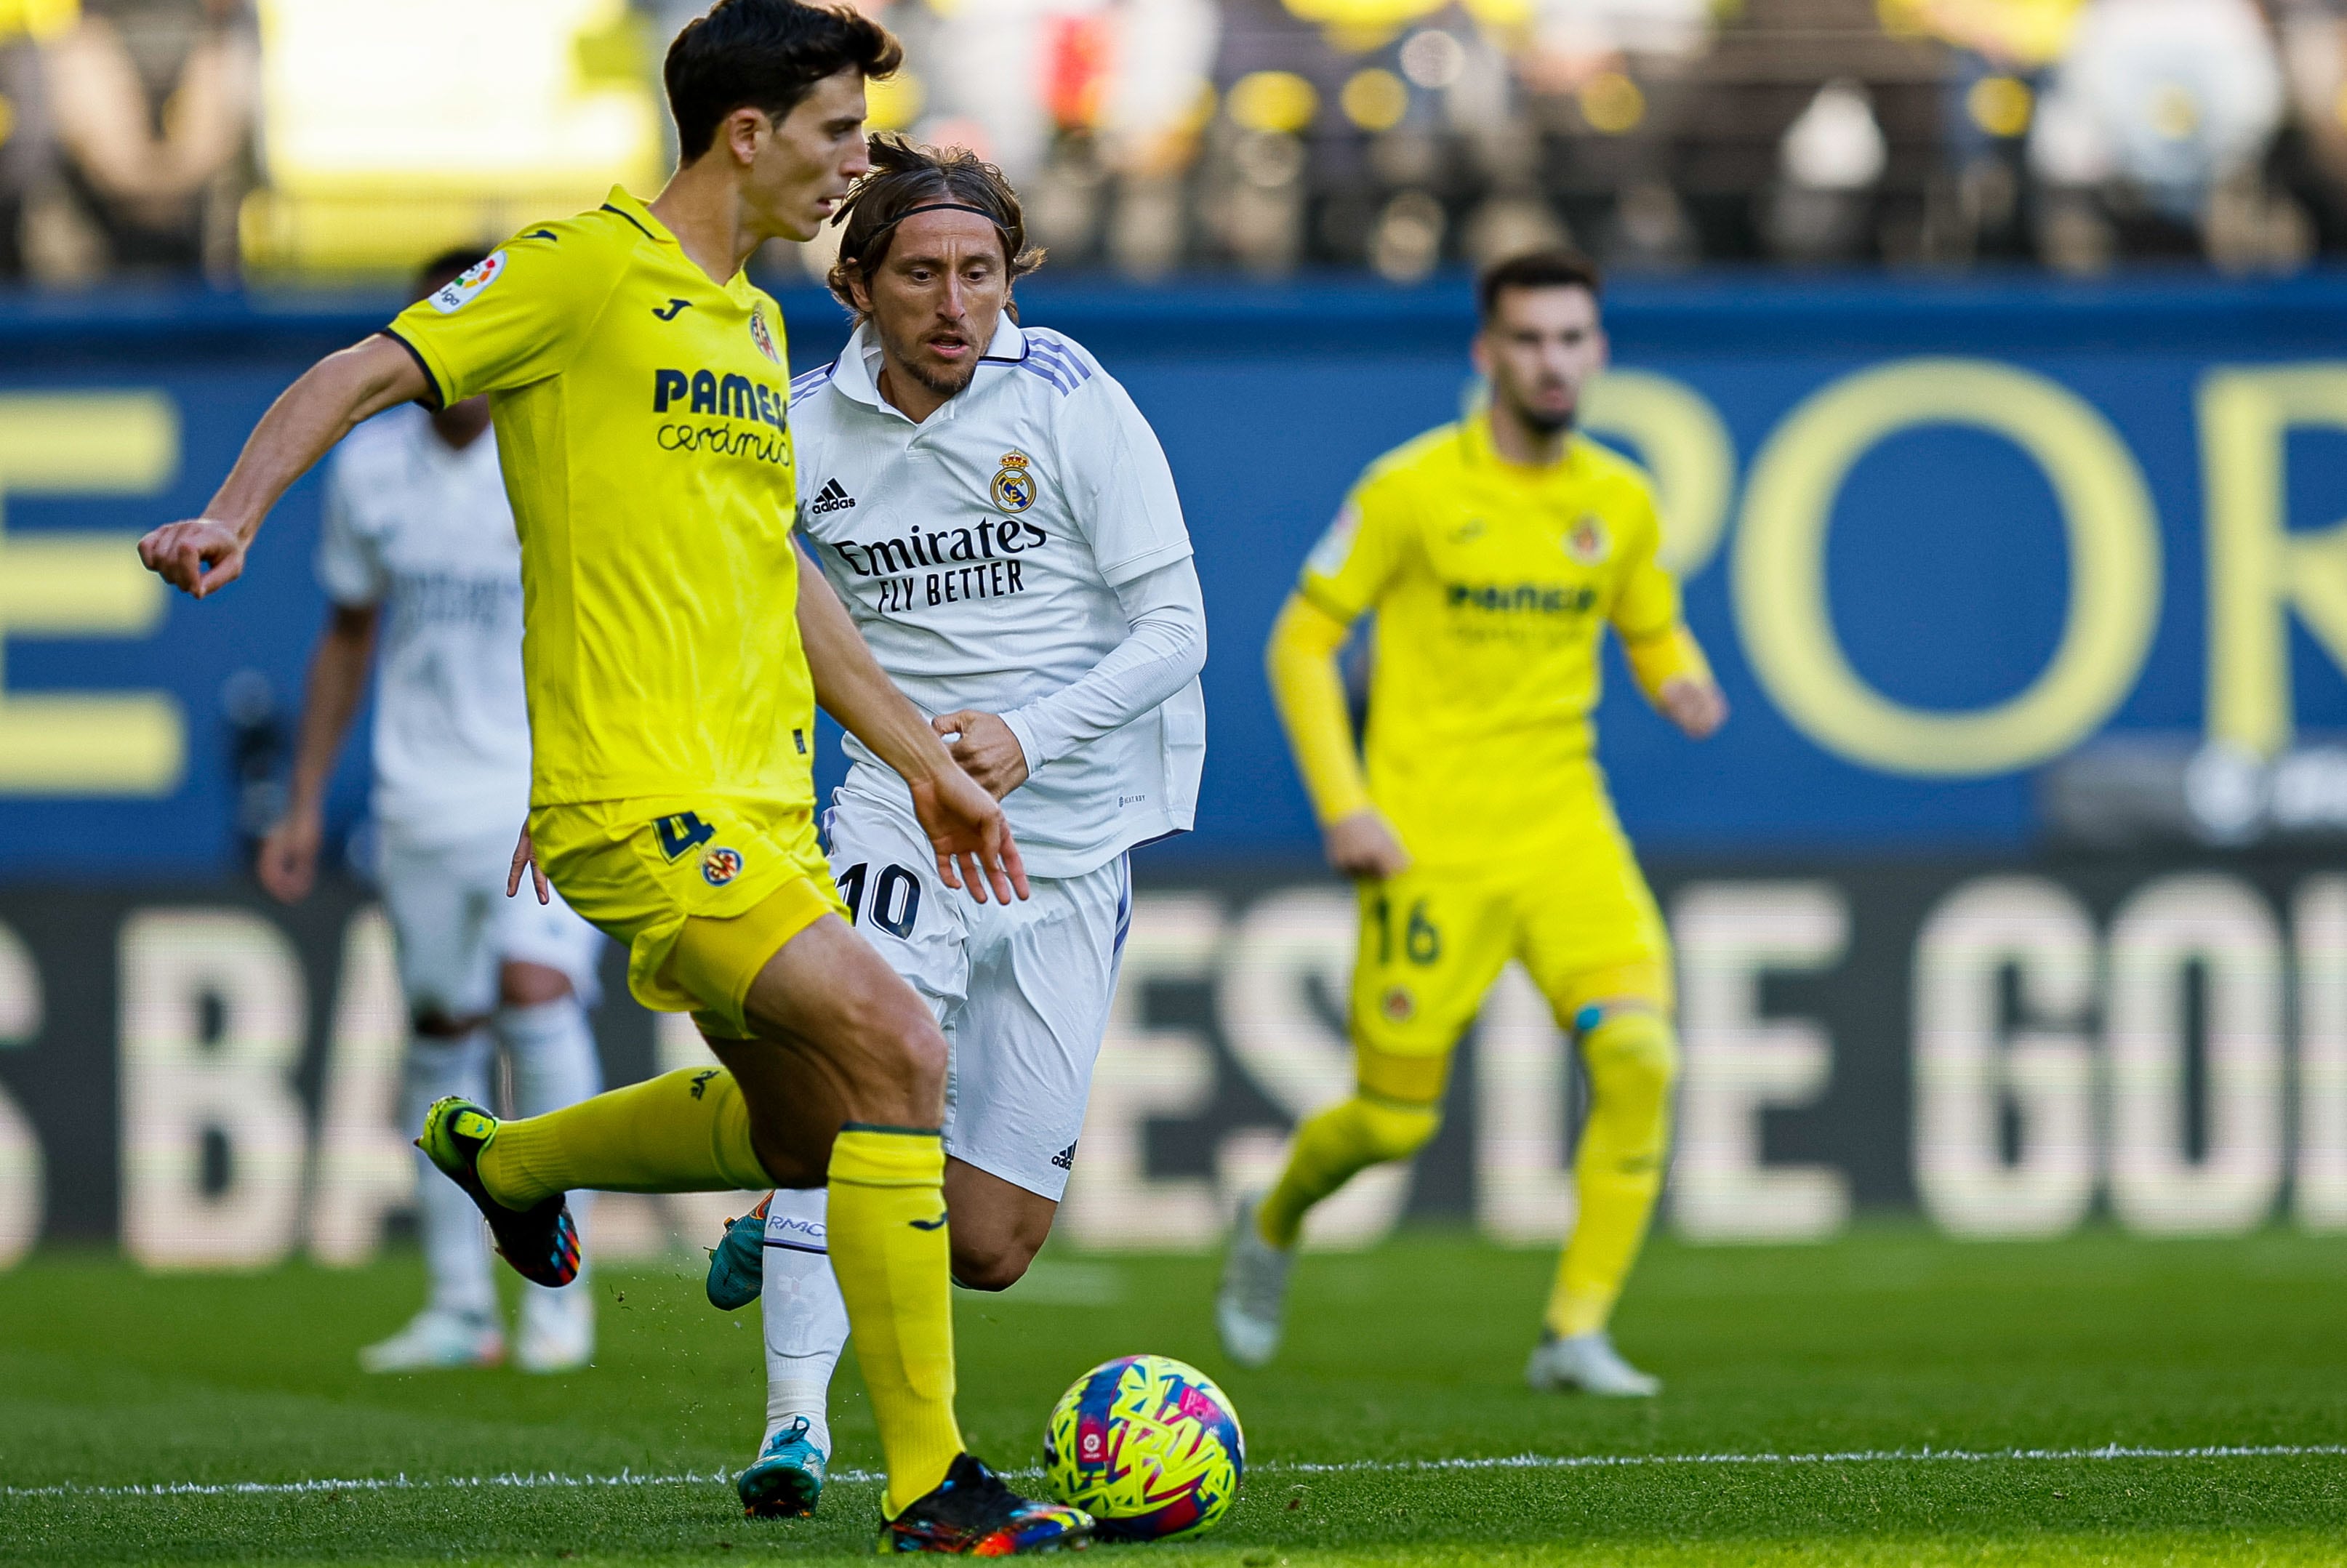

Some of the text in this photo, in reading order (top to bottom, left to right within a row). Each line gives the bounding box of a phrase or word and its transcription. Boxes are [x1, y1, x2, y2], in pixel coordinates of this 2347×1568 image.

[811, 497, 856, 515] adidas
[833, 516, 1047, 577] Emirates
[878, 559, 1024, 614] FLY BETTER
[652, 811, 717, 866] 4
[834, 859, 921, 941] 10
[1373, 895, 1443, 967] 16
